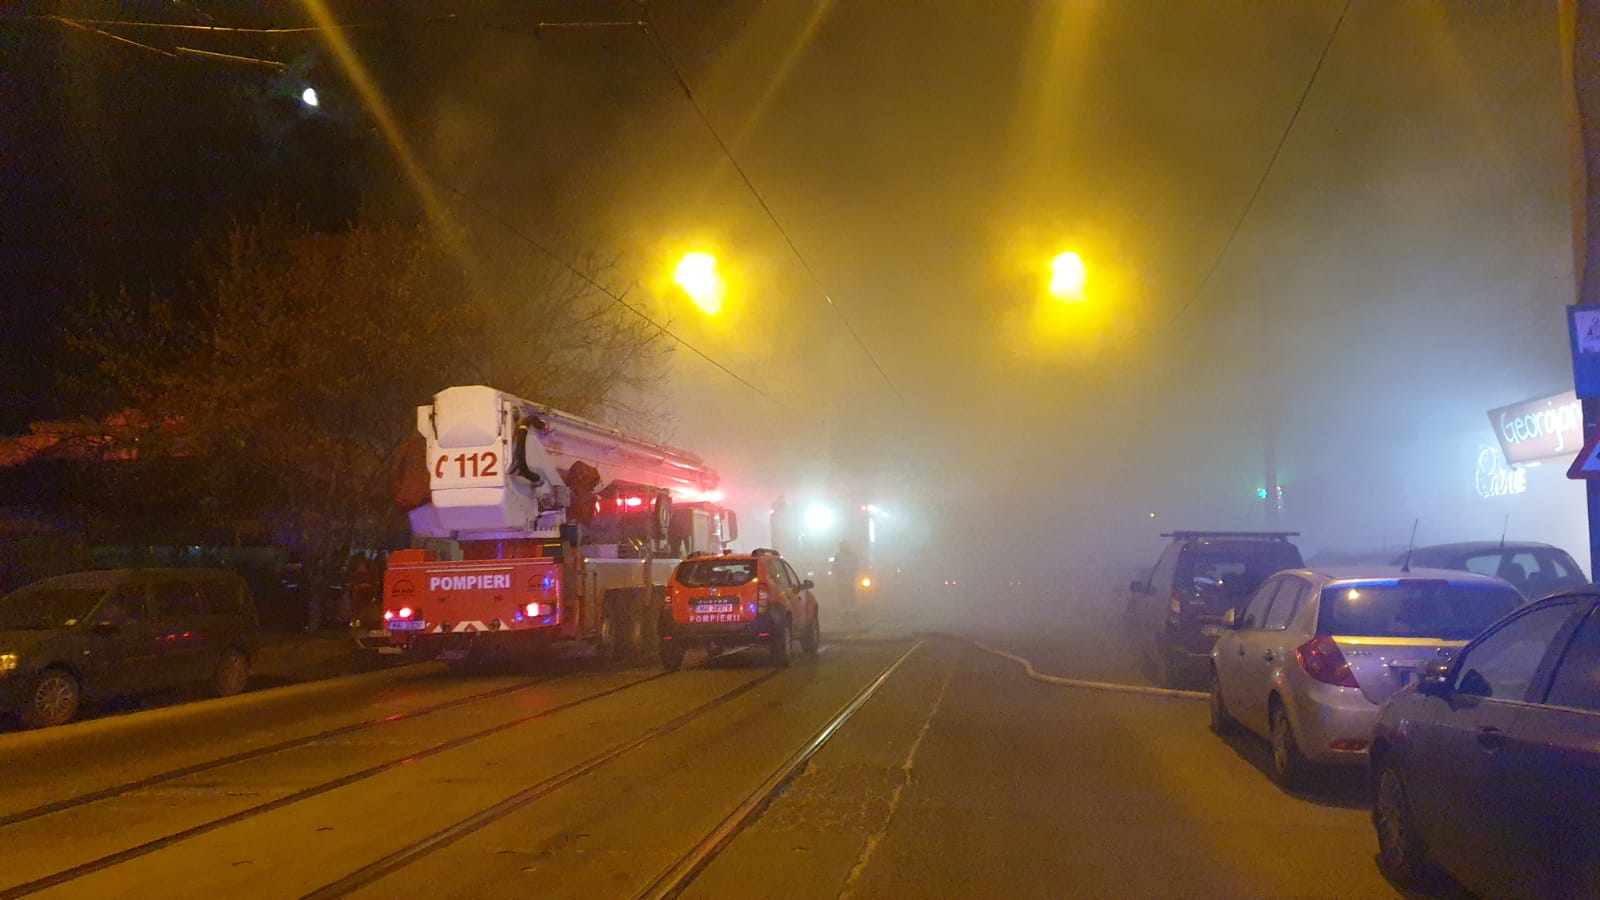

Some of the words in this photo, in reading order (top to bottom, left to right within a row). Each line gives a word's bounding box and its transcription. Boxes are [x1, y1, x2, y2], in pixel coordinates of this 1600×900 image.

[454, 452, 497, 478] 112
[430, 574, 511, 591] POMPIERI
[689, 614, 740, 622] POMPIERII
